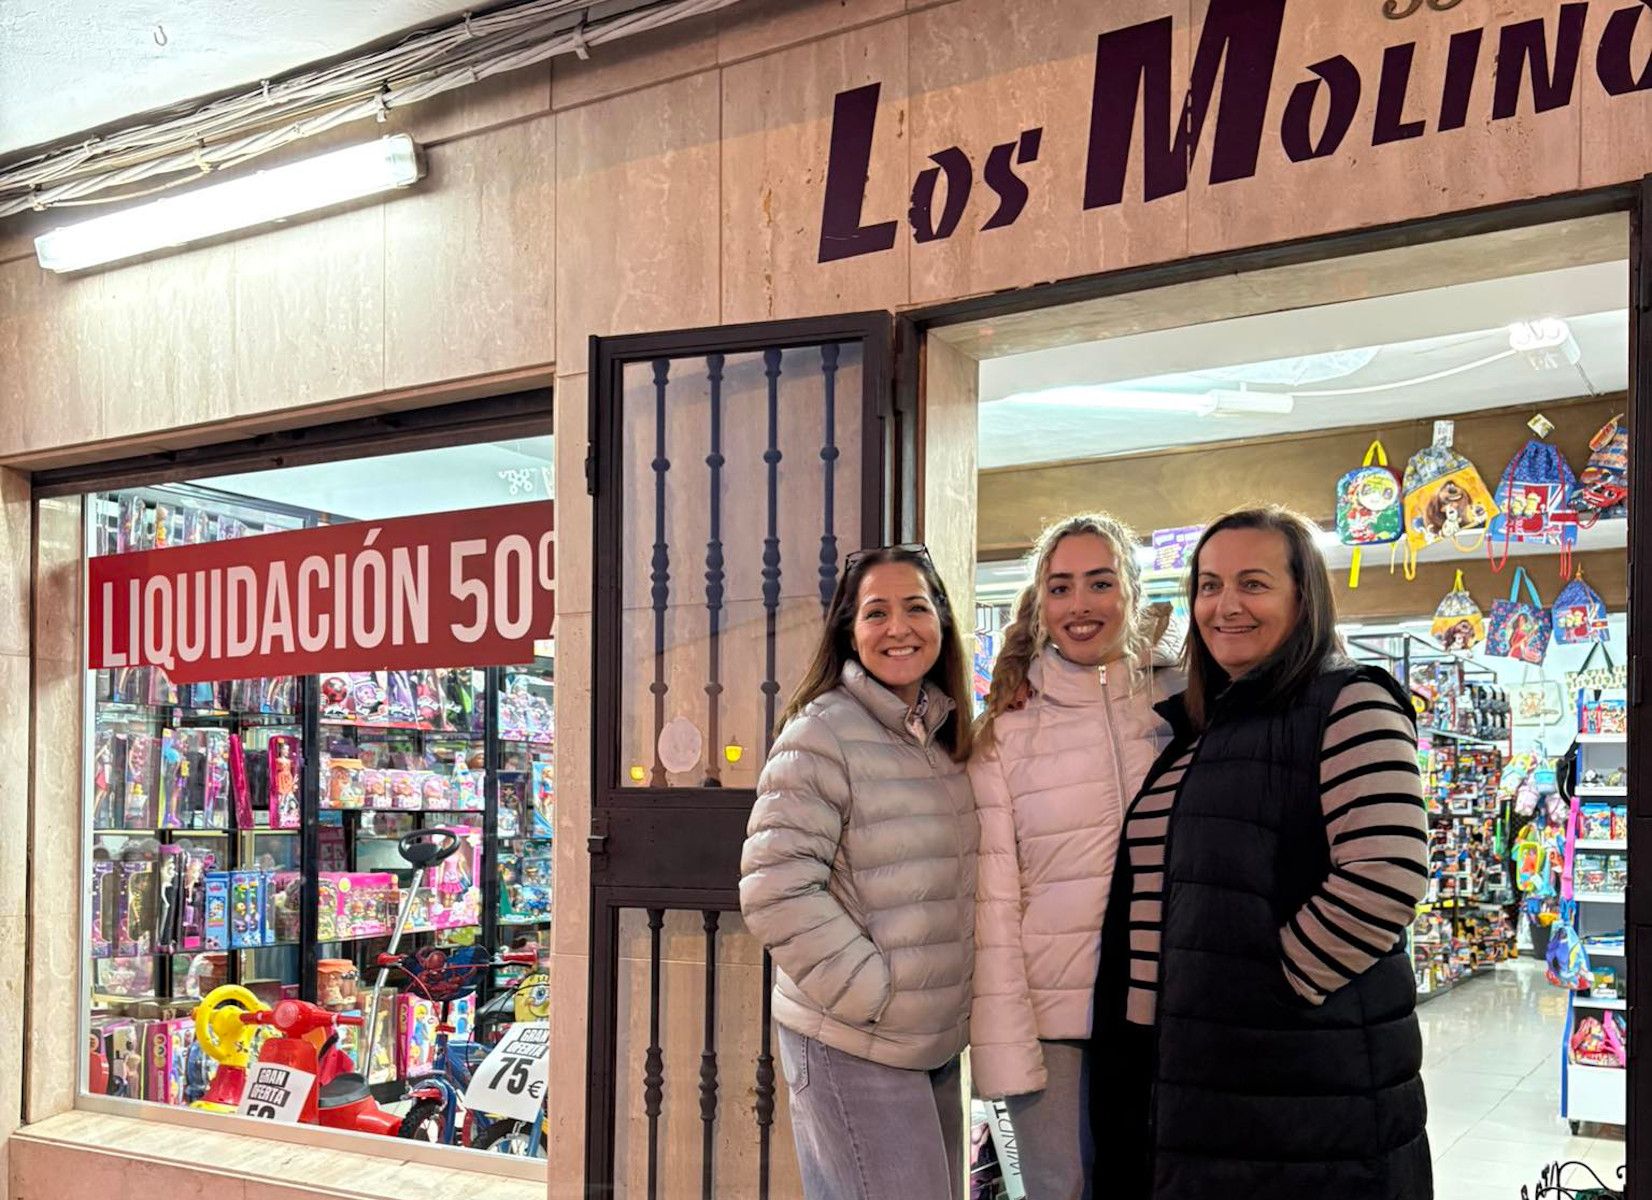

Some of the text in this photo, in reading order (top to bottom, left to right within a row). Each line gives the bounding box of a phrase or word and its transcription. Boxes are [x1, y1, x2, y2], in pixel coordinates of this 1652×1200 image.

[102, 528, 429, 670] LIQUIDACIÓN
[258, 1068, 286, 1087] GRAN
[250, 1084, 285, 1105] OFERTA
